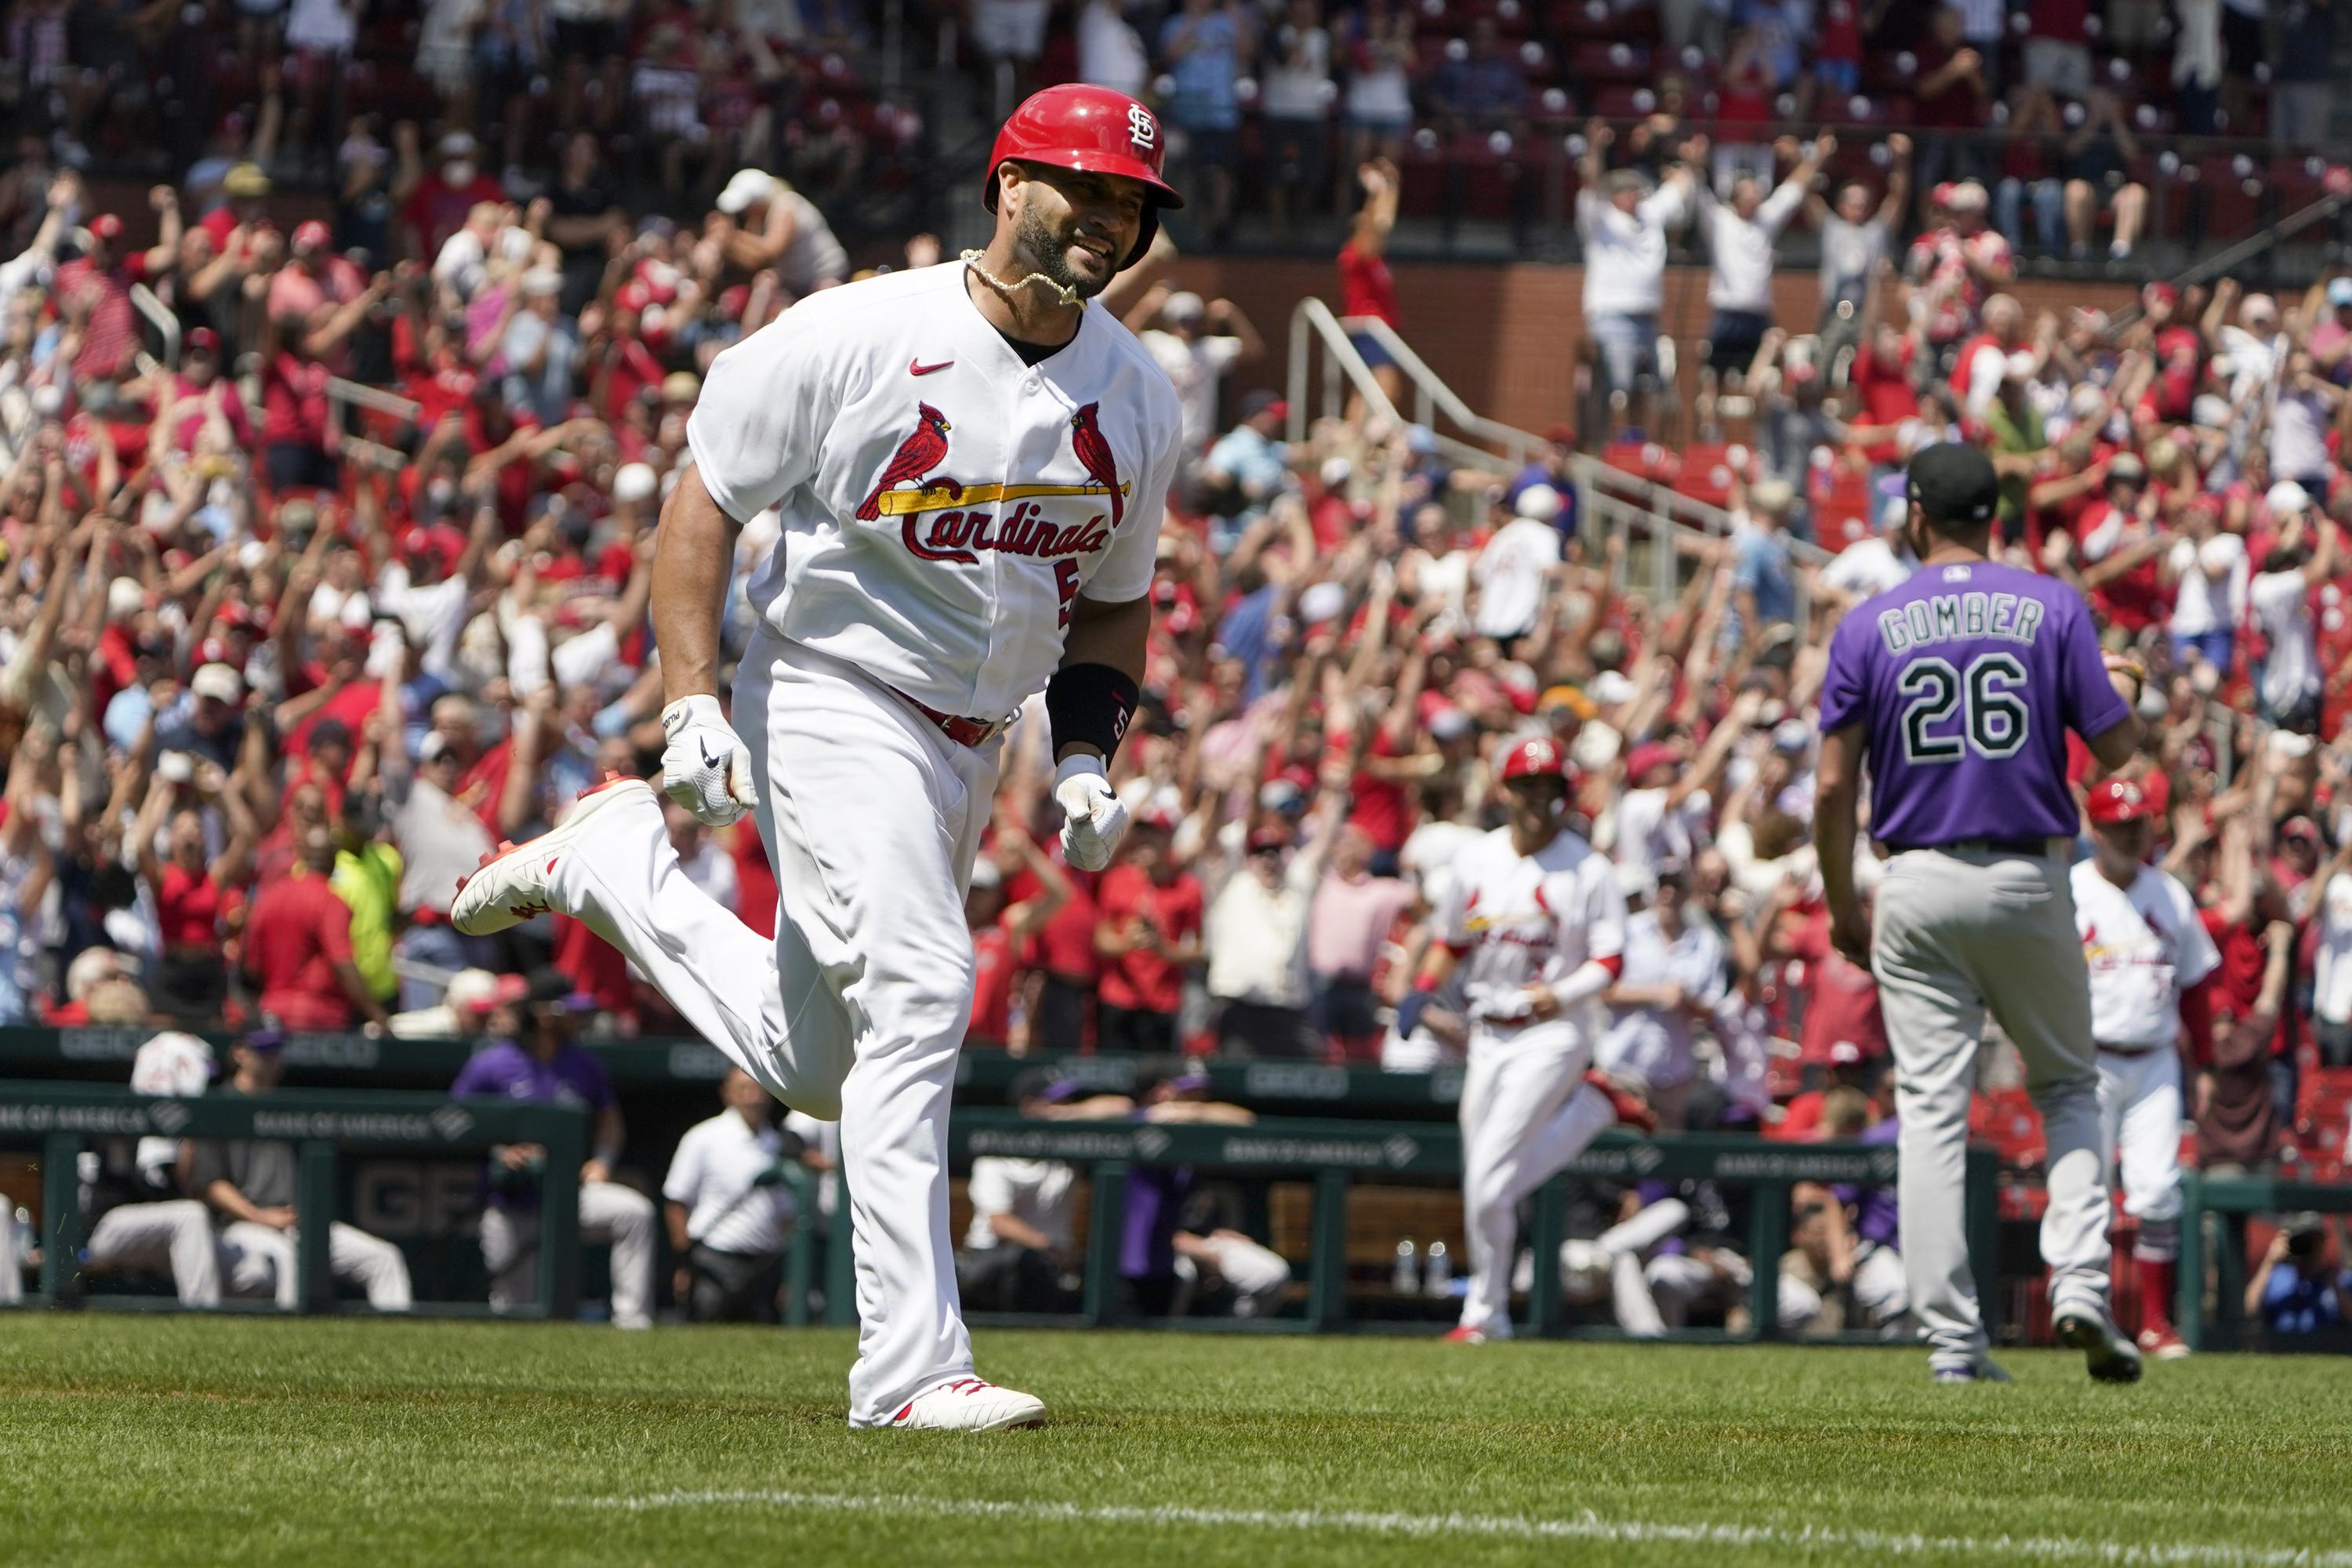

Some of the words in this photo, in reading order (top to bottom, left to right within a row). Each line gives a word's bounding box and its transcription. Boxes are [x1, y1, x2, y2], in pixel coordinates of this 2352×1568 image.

[902, 477, 1109, 565] Cardinals
[1878, 592, 2045, 658] GOMBER
[1897, 652, 2029, 765] 26
